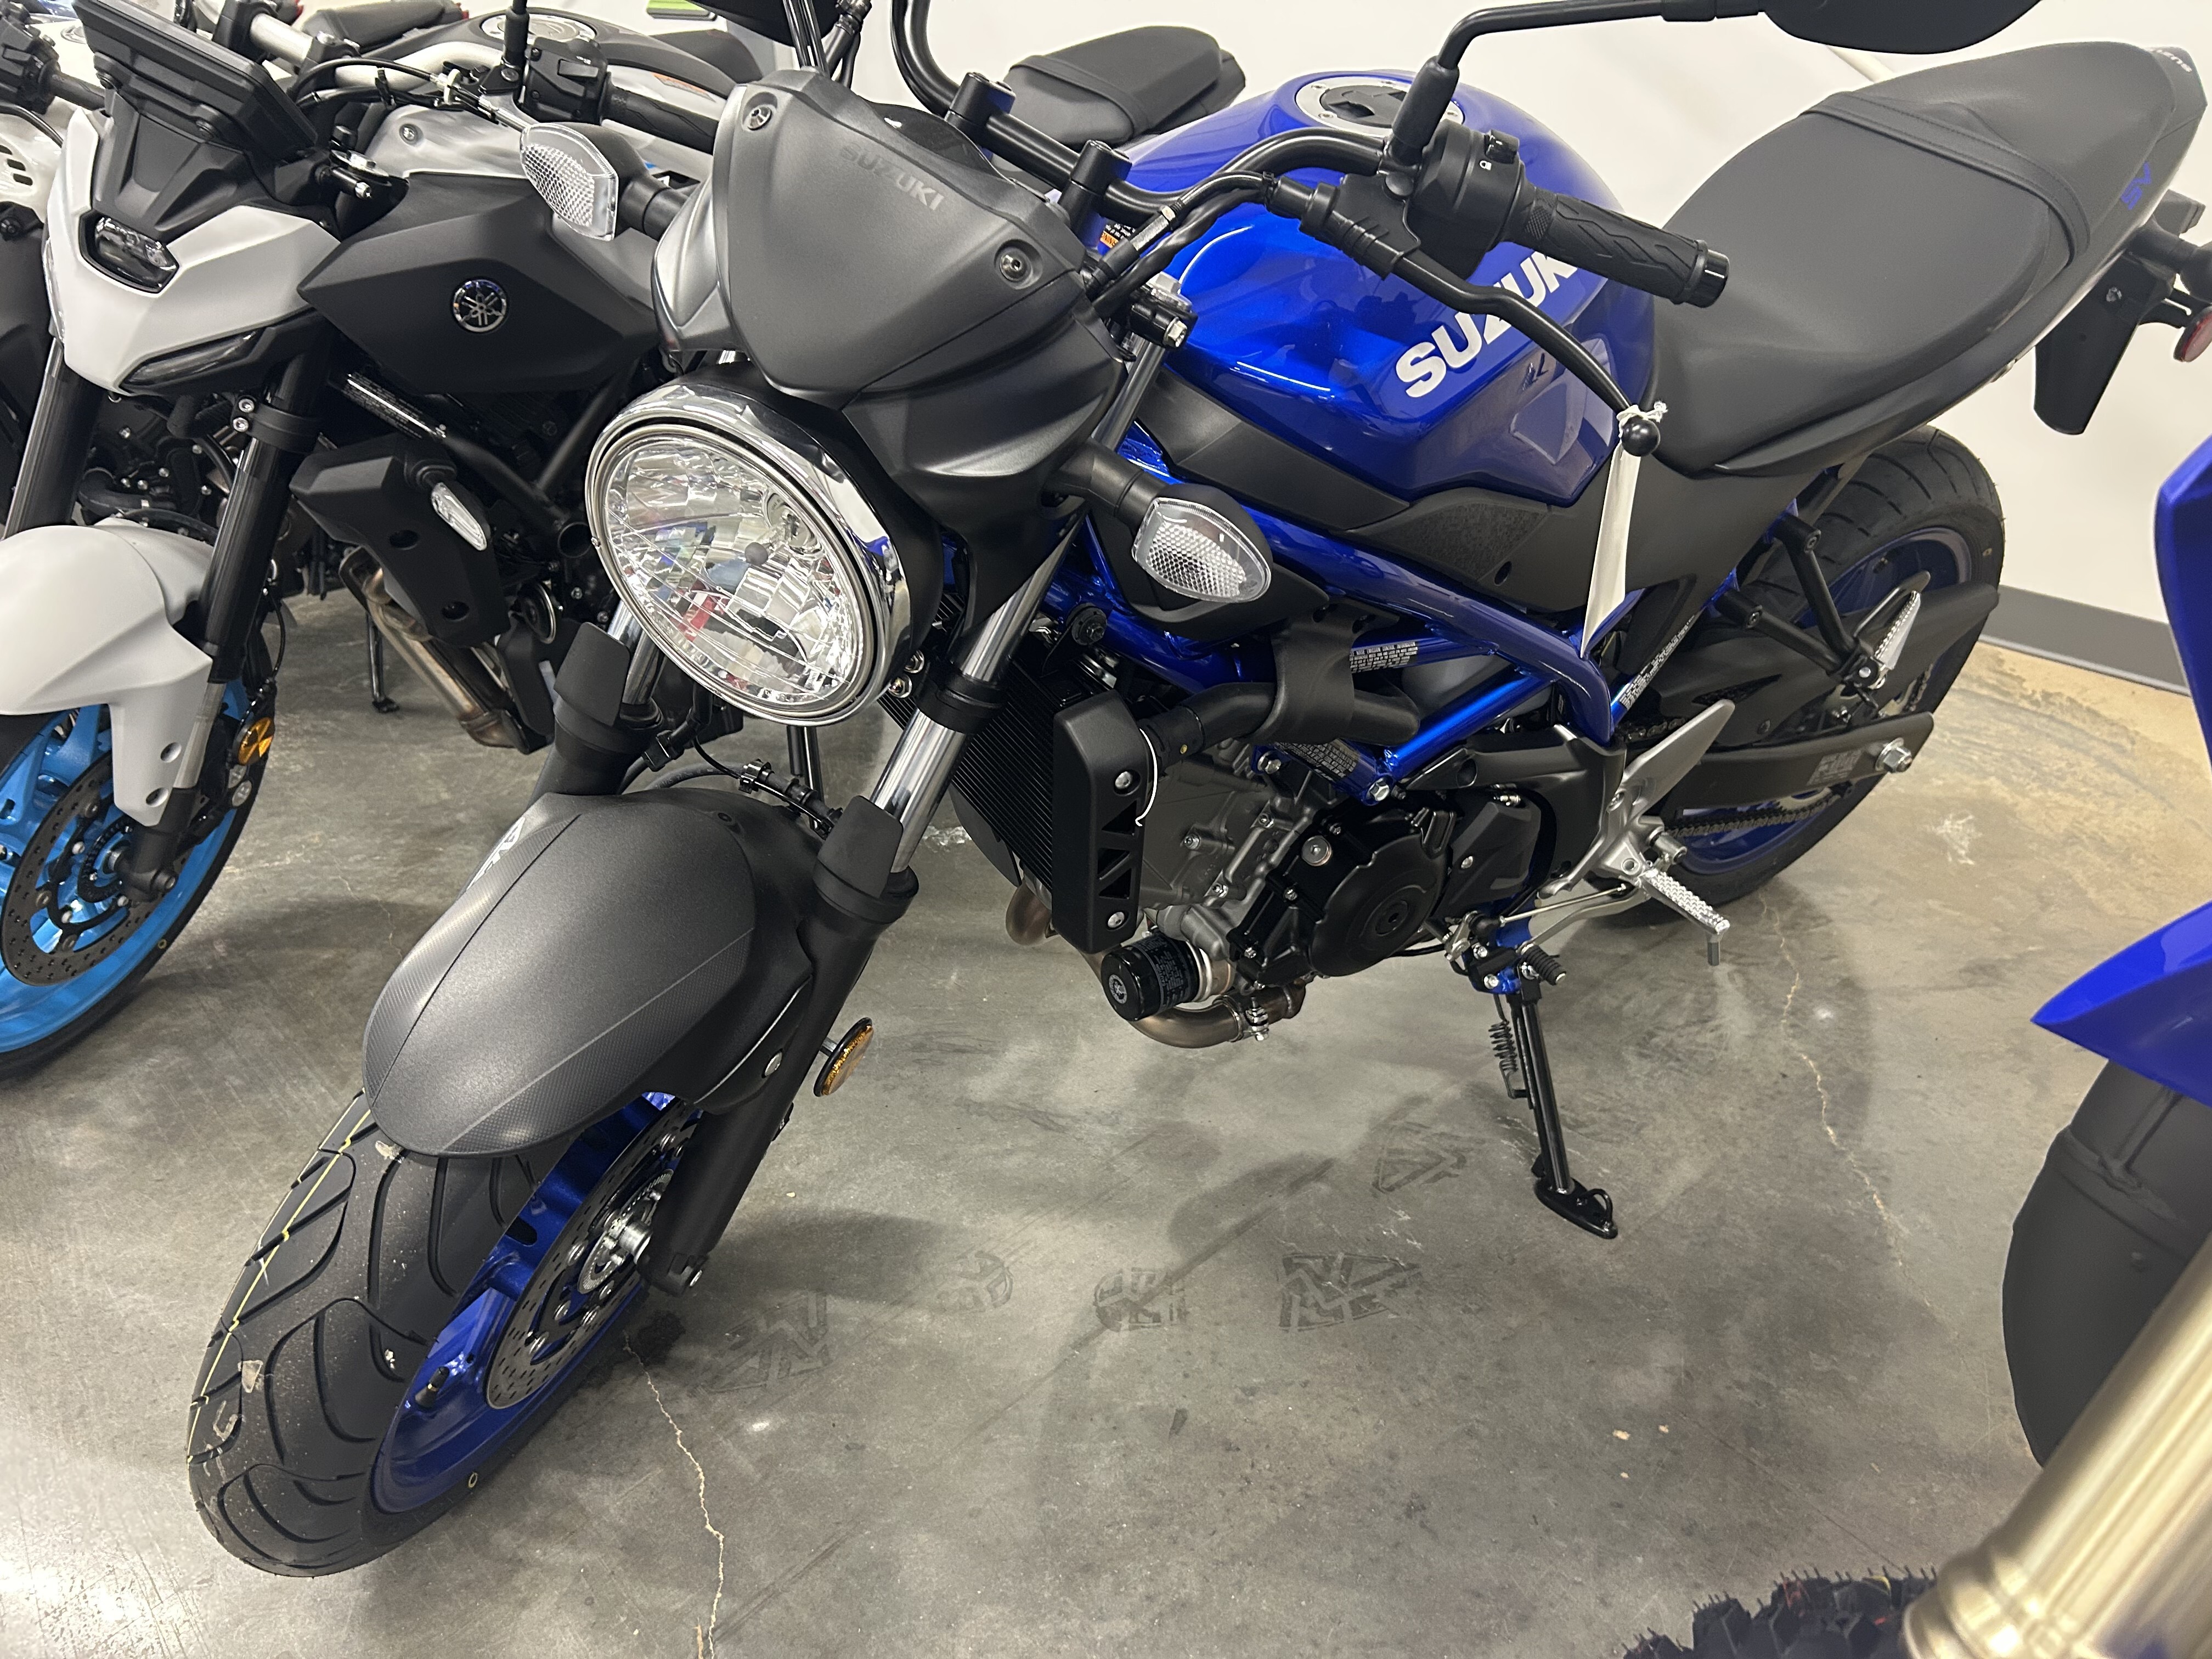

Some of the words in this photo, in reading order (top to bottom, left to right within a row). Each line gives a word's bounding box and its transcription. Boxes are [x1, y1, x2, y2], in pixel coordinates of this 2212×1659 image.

[840, 142, 945, 210] SUZUKI
[2121, 162, 2151, 211] SV
[1396, 251, 1578, 398] SUZUK
